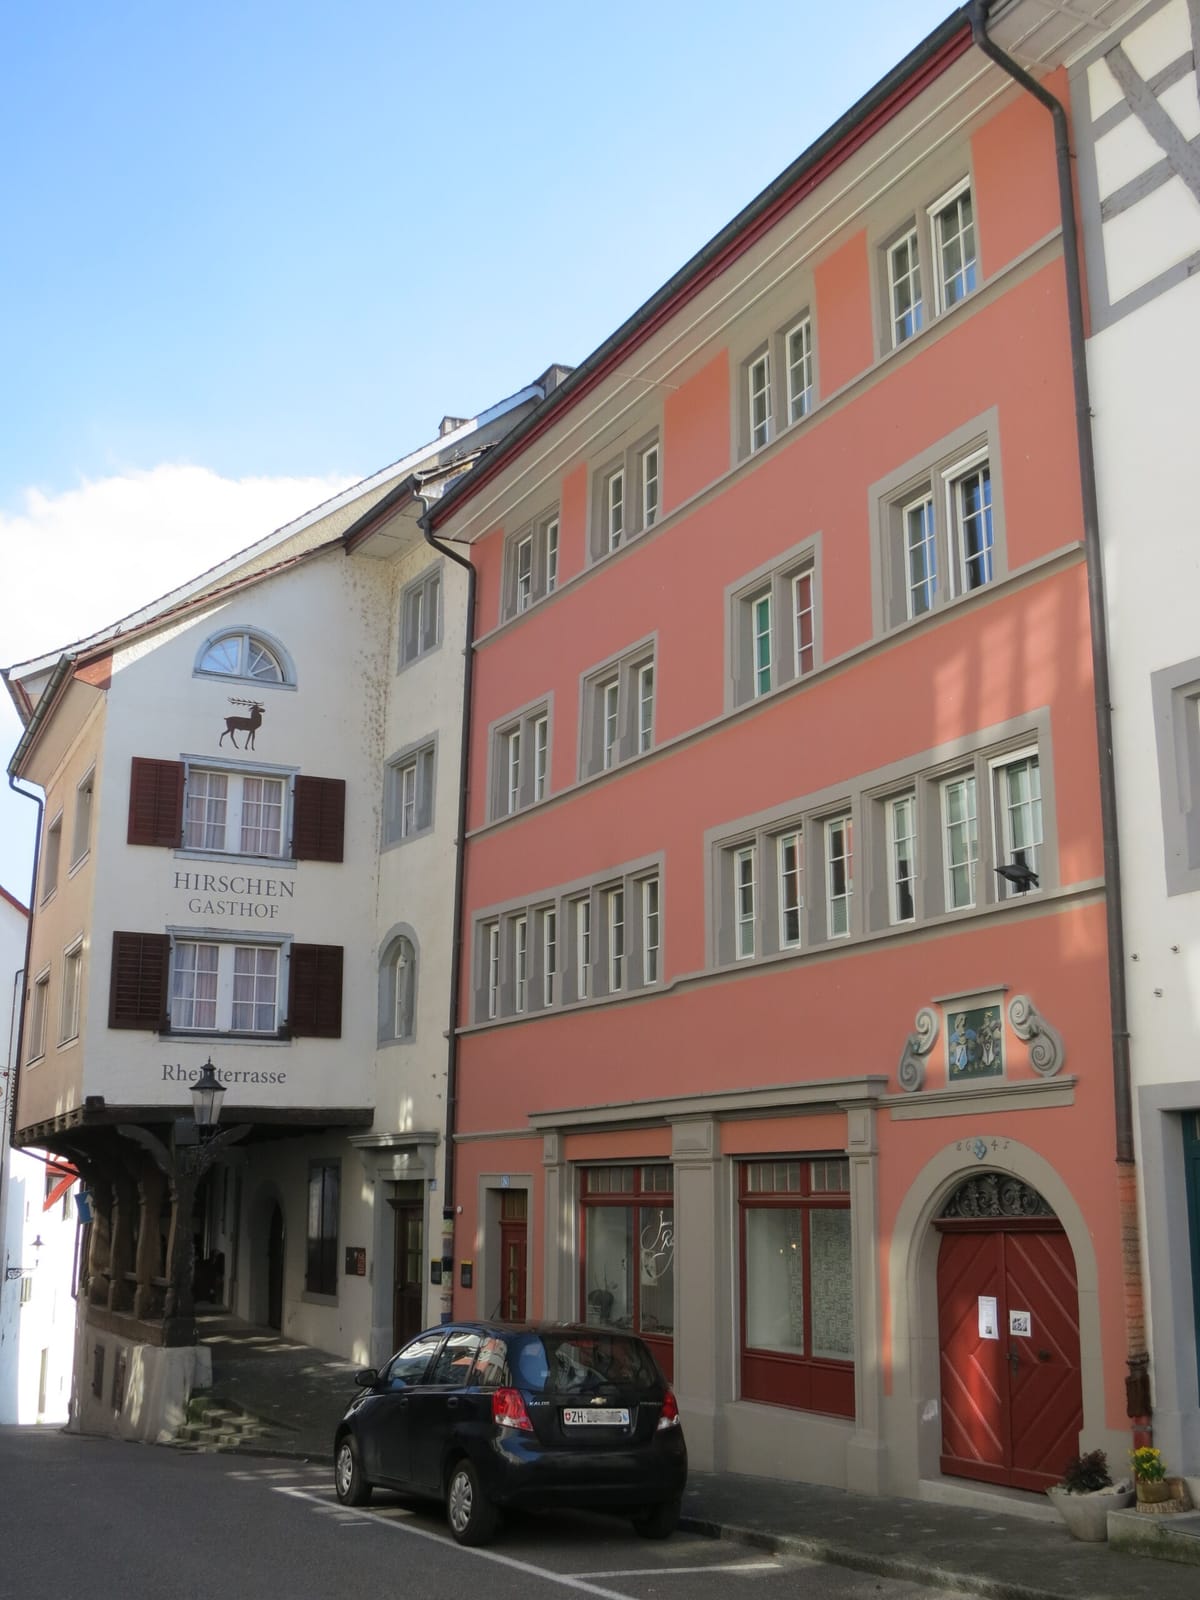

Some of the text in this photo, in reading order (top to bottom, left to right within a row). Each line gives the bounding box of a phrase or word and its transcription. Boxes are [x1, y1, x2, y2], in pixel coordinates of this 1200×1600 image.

[174, 872, 296, 898] HIRSCHEN
[188, 898, 279, 919] GASTHOF
[161, 1063, 287, 1084] Rheiterrasse
